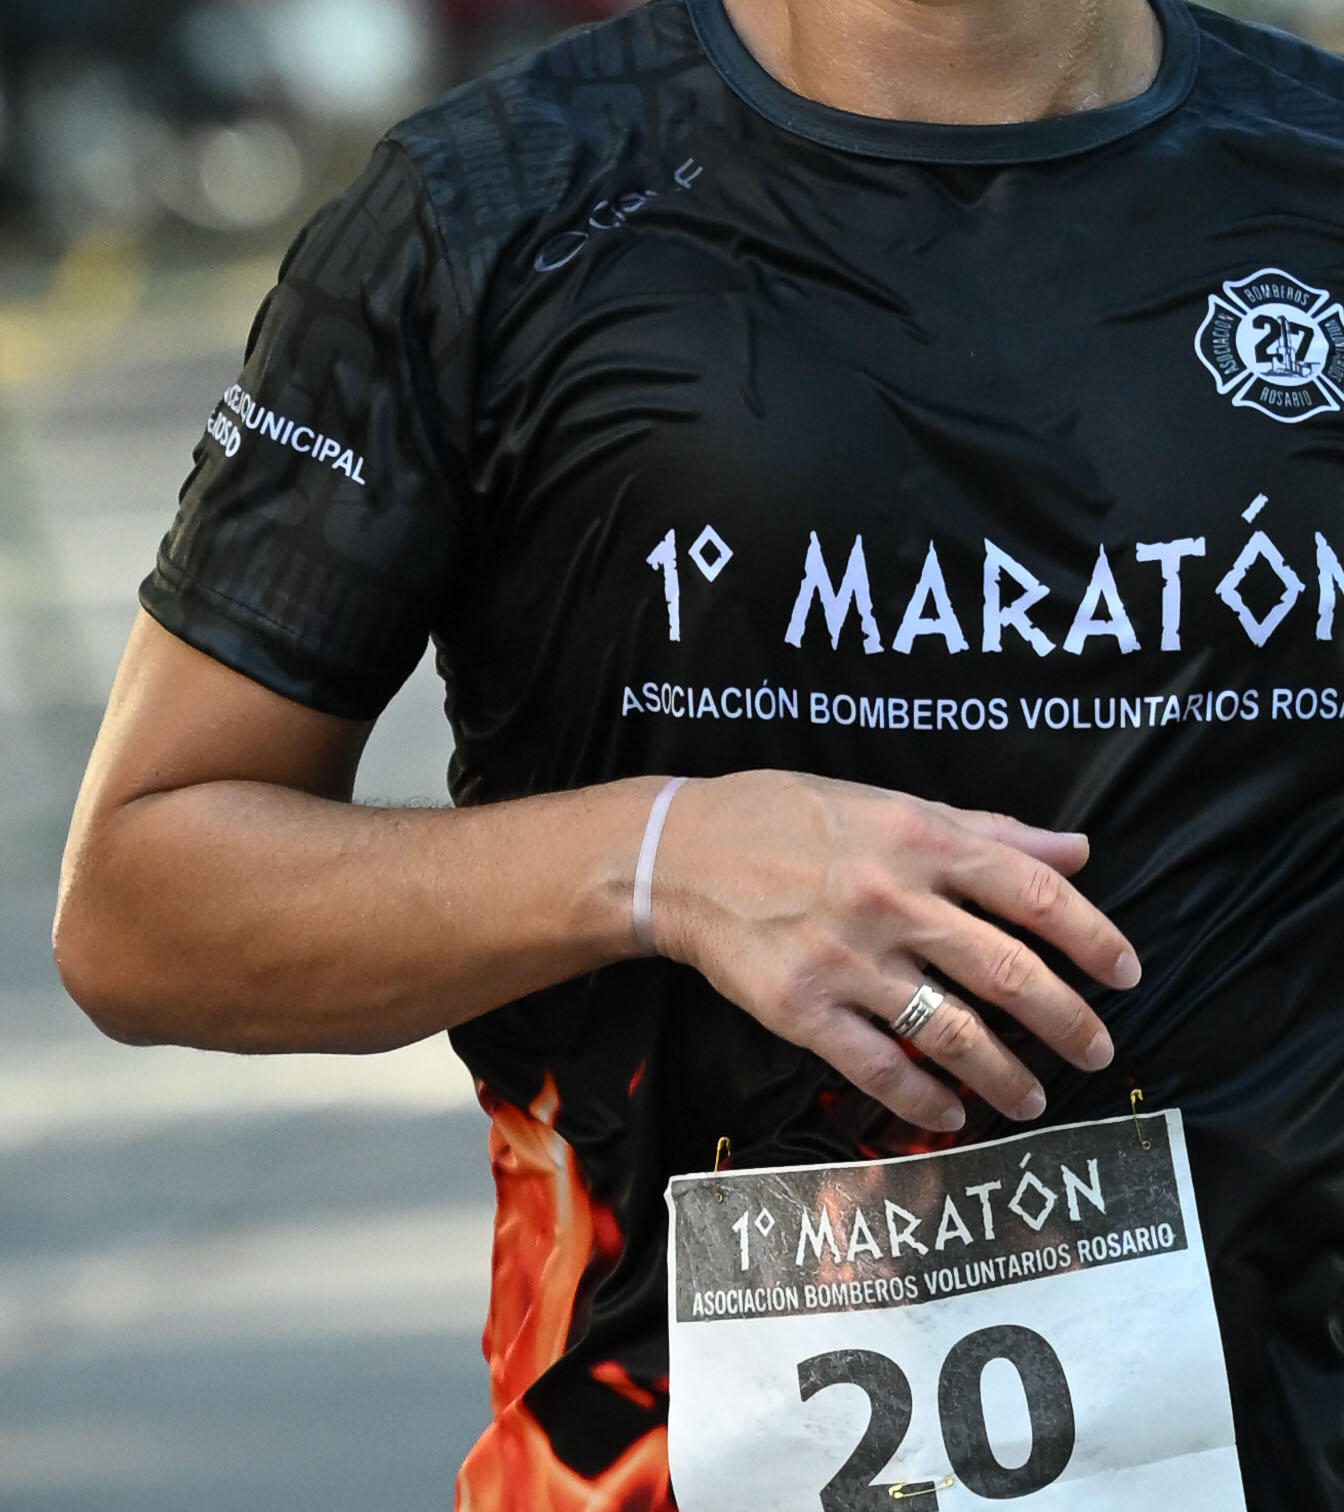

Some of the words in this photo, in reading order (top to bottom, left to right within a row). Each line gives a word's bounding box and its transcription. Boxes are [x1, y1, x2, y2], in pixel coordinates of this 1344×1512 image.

[1243, 284, 1310, 307] BOMBEROS
[1252, 313, 1315, 364] 27
[1259, 386, 1313, 408] ROSARIO
[622, 678, 799, 720] ASOCIACIÓN
[810, 692, 1009, 730] BOMBEROS
[1019, 688, 1260, 730] VOLUNTARIOS
[794, 1151, 1106, 1267] MARATÓN
[692, 1281, 799, 1317] ASOCIACIÓN
[804, 1274, 919, 1309] BOMBEROS
[923, 1243, 1073, 1296] VOLUNTARIOS
[1076, 1222, 1176, 1265] ROSARIO
